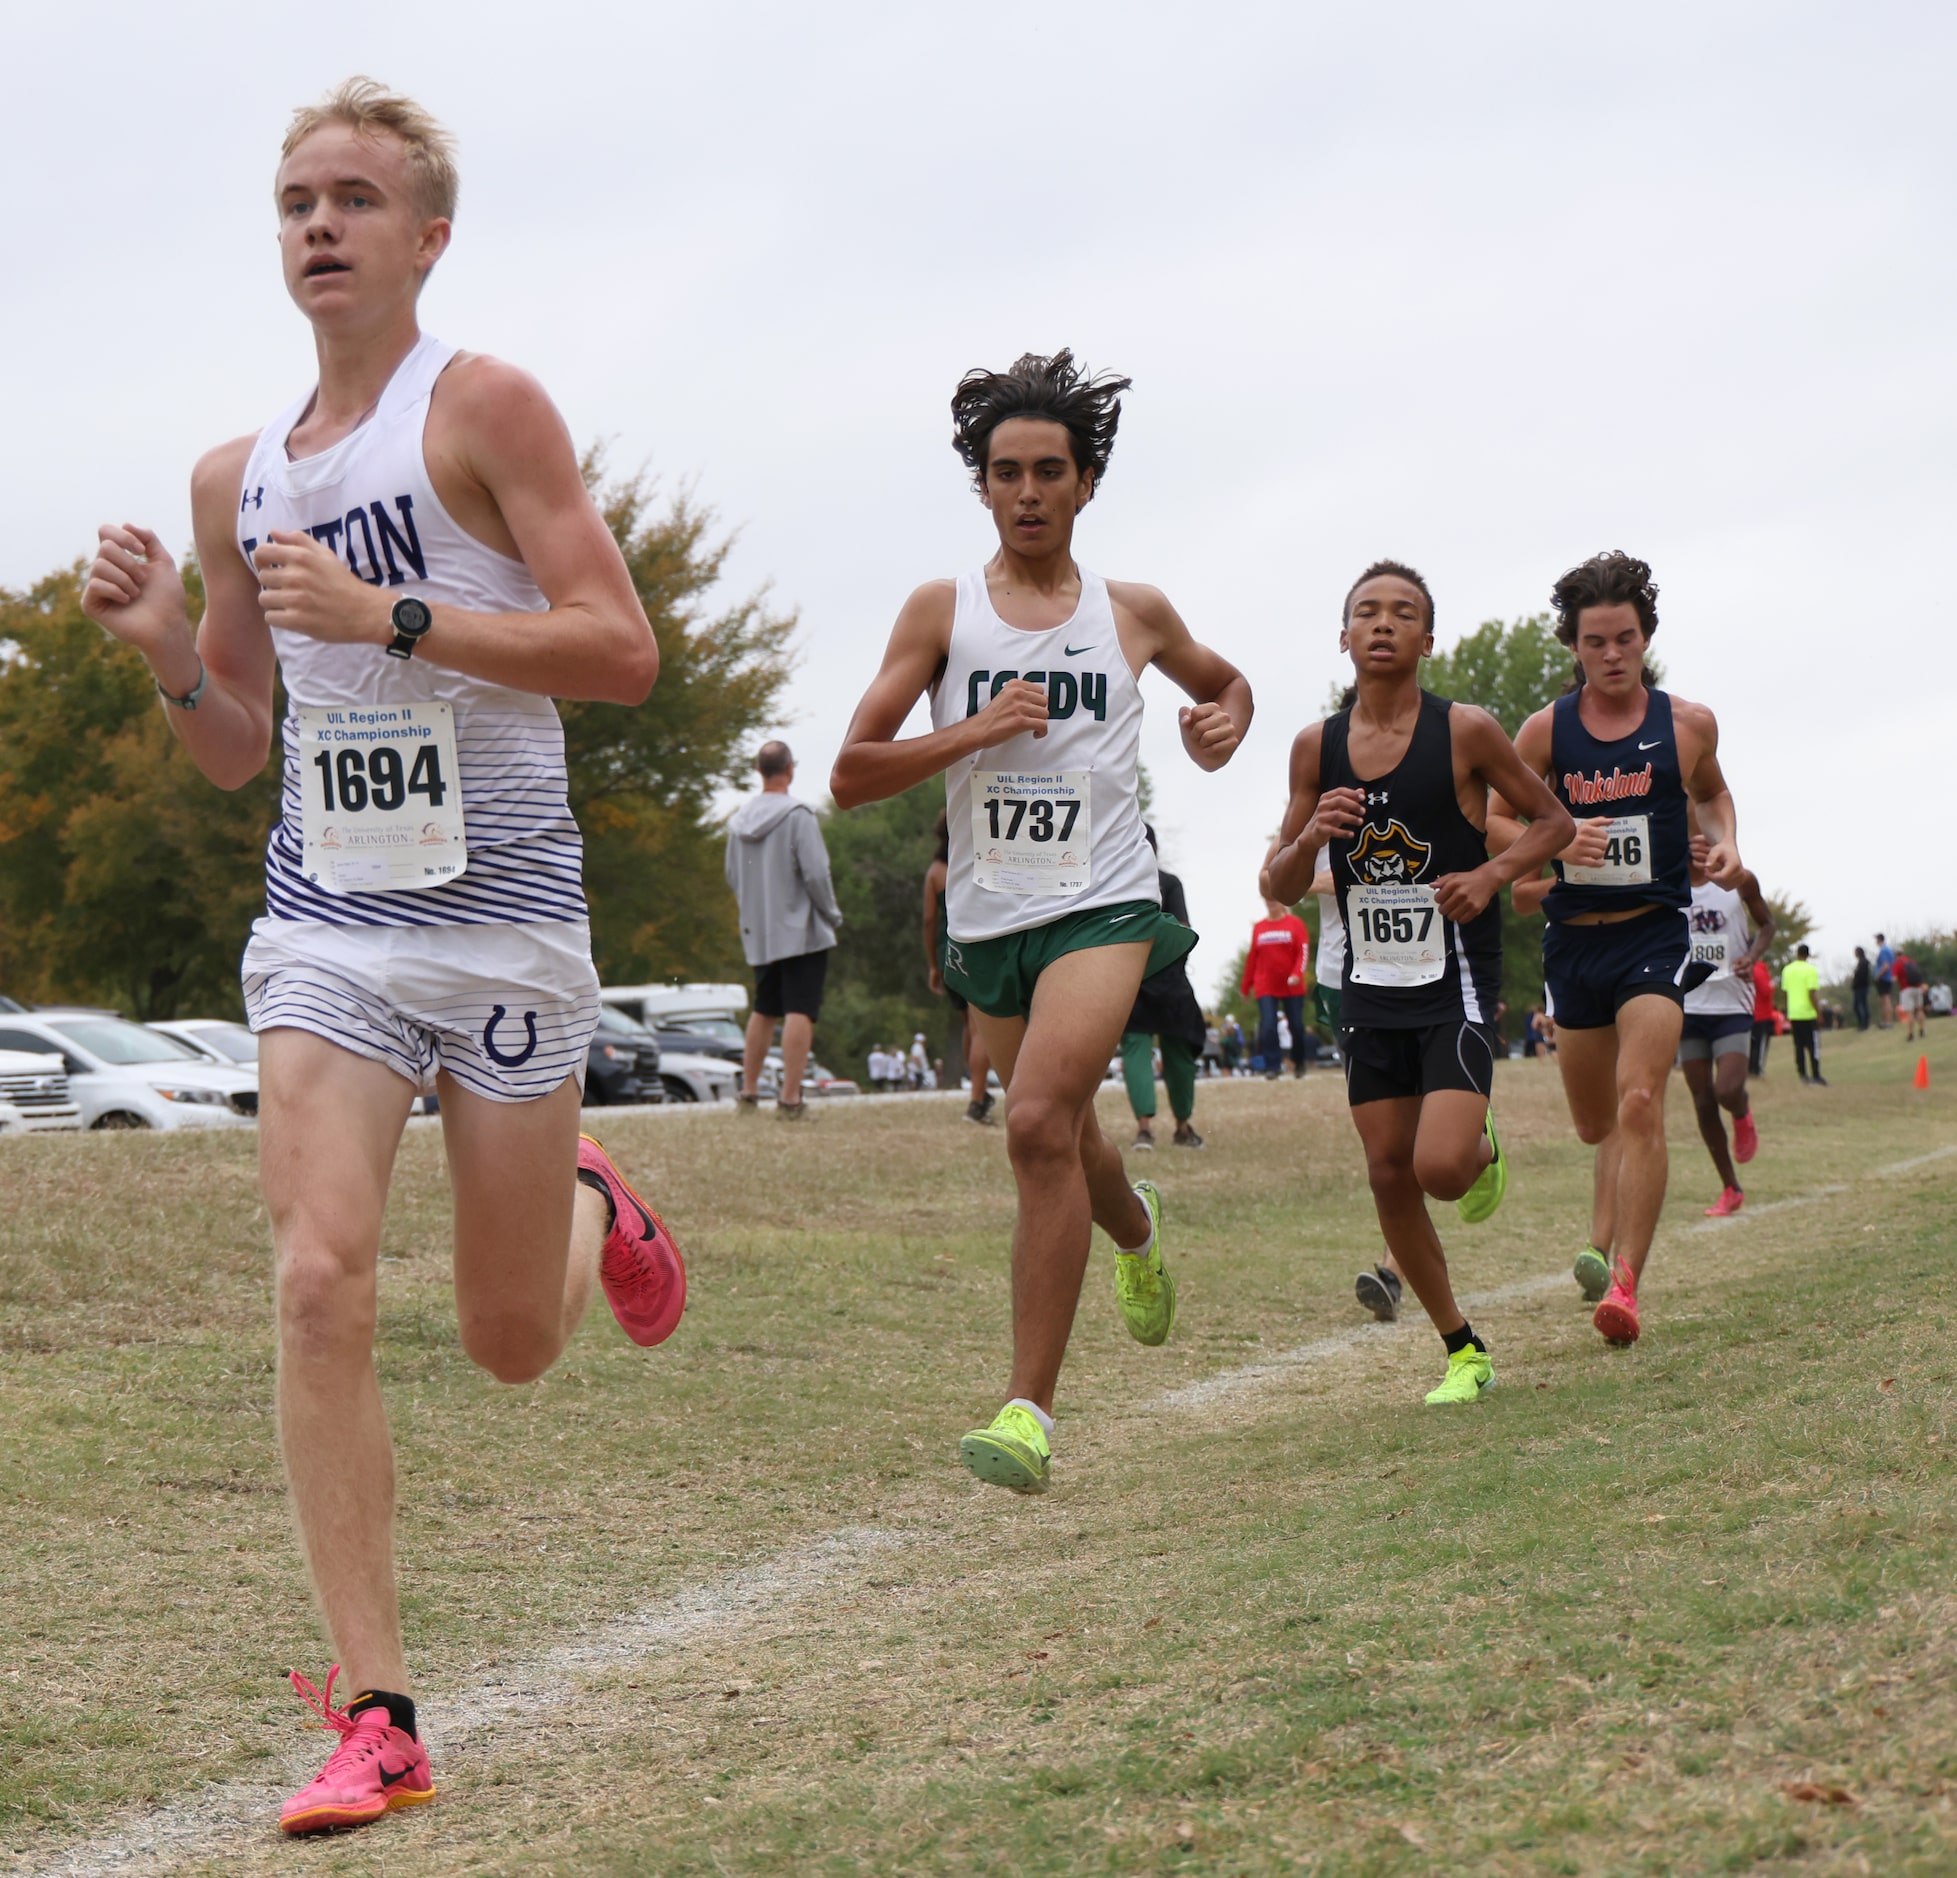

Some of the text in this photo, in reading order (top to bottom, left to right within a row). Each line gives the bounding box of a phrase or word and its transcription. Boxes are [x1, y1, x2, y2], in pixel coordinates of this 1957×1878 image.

[327, 709, 412, 725] UIL Region II
[317, 725, 432, 742] XC Championship
[314, 744, 447, 813] 1694
[1017, 775, 1053, 785] Region
[1056, 775, 1063, 783] II
[1563, 761, 1653, 805] Wakeland
[986, 786, 1075, 796] XC Championship
[984, 799, 1081, 843] 1737
[348, 834, 408, 845] ARLINGTON
[1008, 856, 1052, 864] ARLINGTON
[424, 867, 436, 876] No.
[1381, 887, 1410, 896] Region
[1371, 896, 1429, 905] Championship
[1357, 907, 1434, 943] 1657
